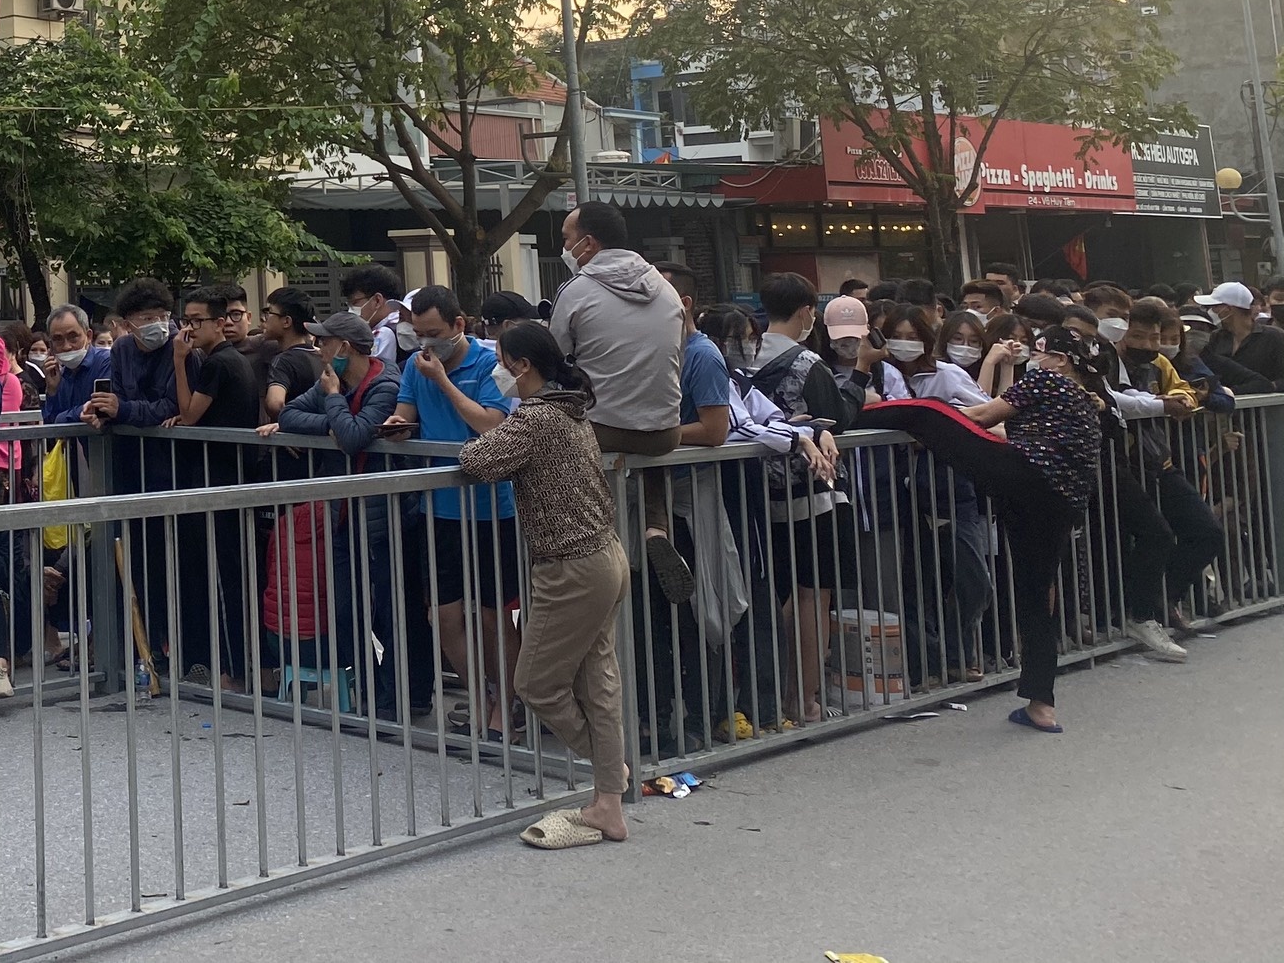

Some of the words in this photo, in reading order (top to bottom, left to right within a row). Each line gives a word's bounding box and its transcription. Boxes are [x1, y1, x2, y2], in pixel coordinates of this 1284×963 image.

[980, 162, 1011, 185] Pizza
[1020, 164, 1076, 192] Spaghetti
[1084, 169, 1119, 190] Drinks
